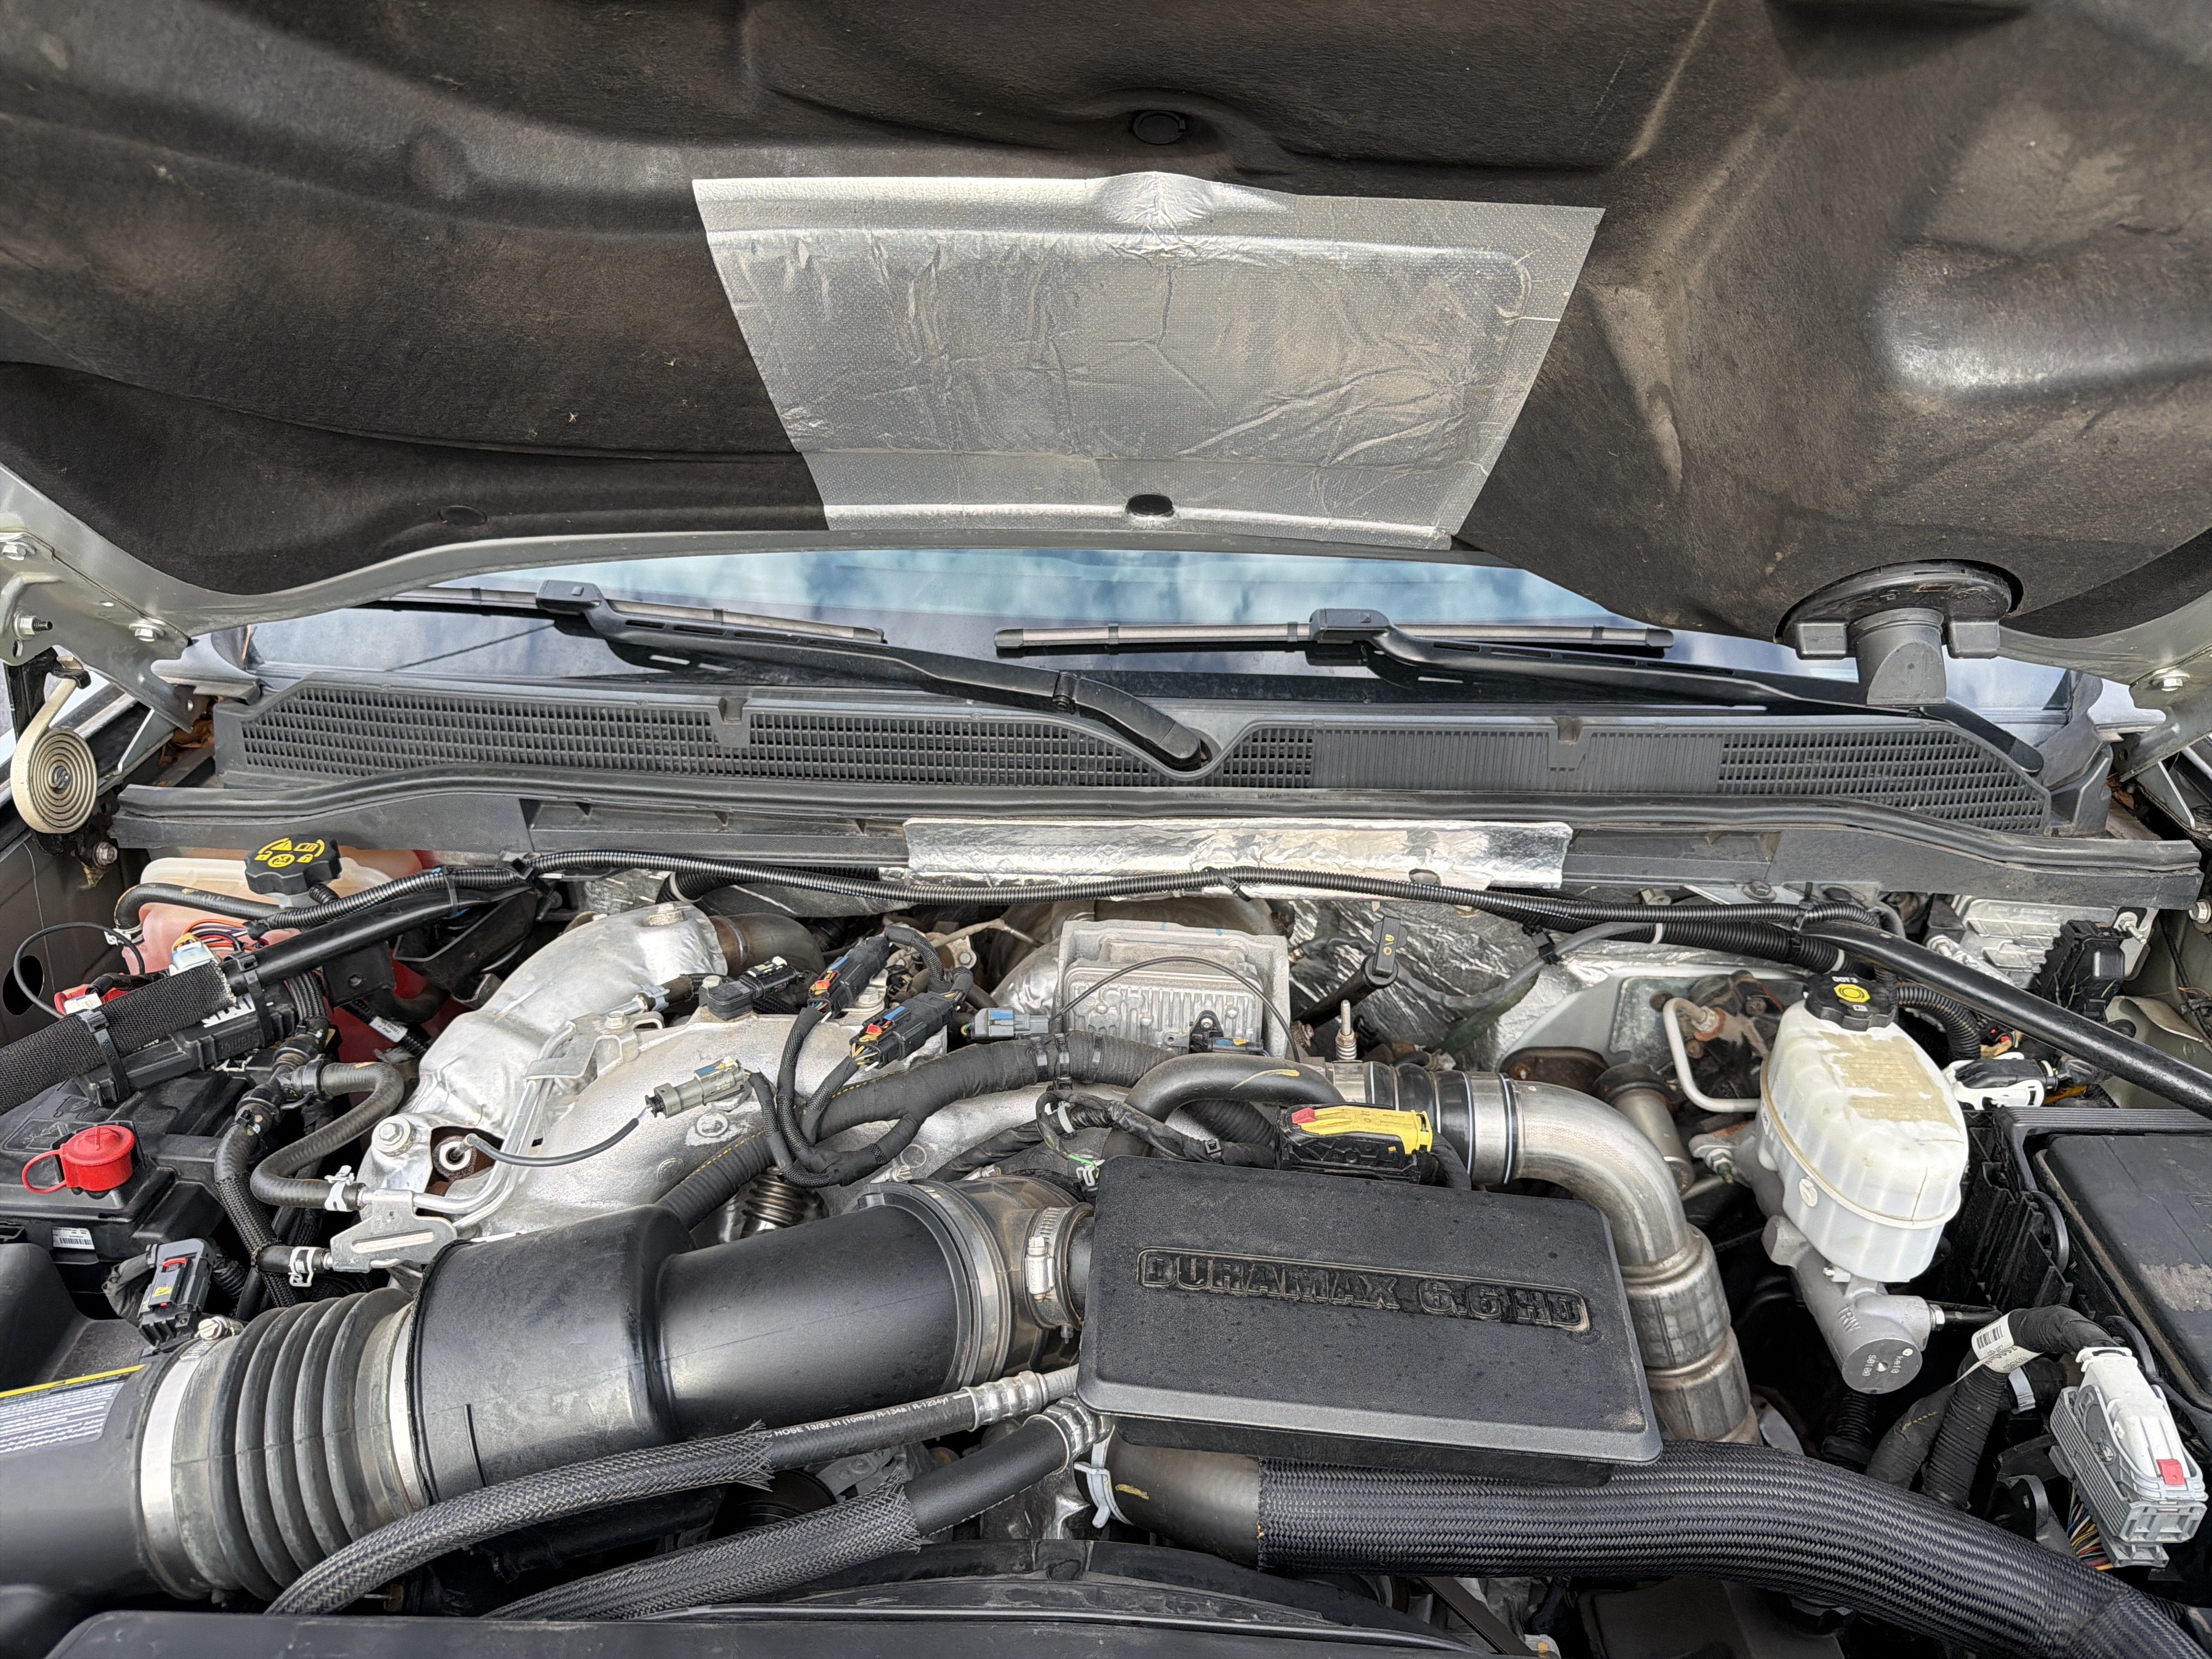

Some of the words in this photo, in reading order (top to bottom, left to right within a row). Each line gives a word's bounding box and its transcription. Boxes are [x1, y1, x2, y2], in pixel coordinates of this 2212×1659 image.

[1143, 1253, 1400, 1310] DURAMAX
[1837, 1303, 1861, 1333] TRW
[774, 1427, 804, 1437] HOSE
[805, 1421, 831, 1431] 13/32
[842, 1413, 875, 1426] (10mm)
[876, 1407, 907, 1418] R-134a
